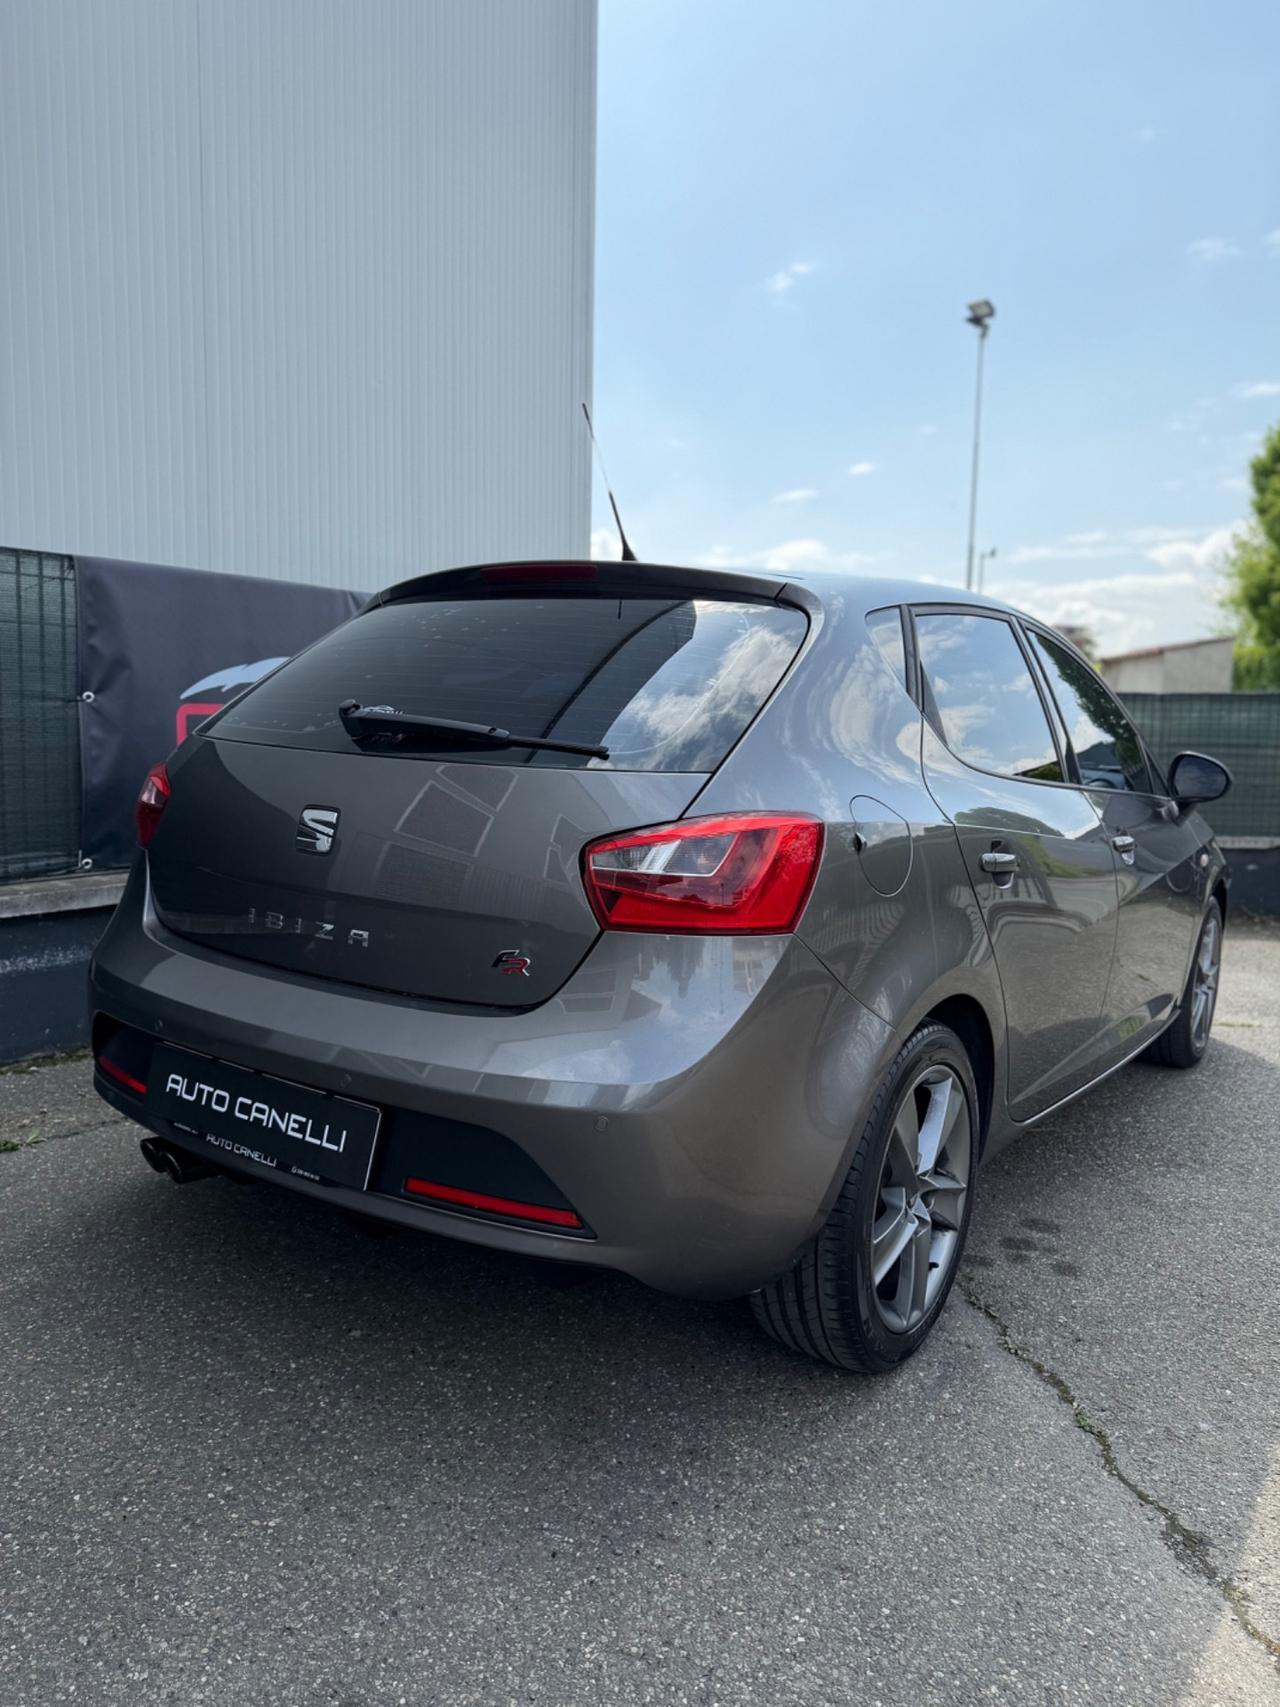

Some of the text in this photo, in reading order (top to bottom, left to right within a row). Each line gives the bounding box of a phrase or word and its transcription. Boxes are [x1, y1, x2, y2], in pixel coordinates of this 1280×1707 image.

[248, 907, 369, 948] IBIZA
[491, 949, 531, 977] FR
[166, 1073, 347, 1152] AUTO CANELLI
[206, 1133, 277, 1167] AUTO CANELLI
